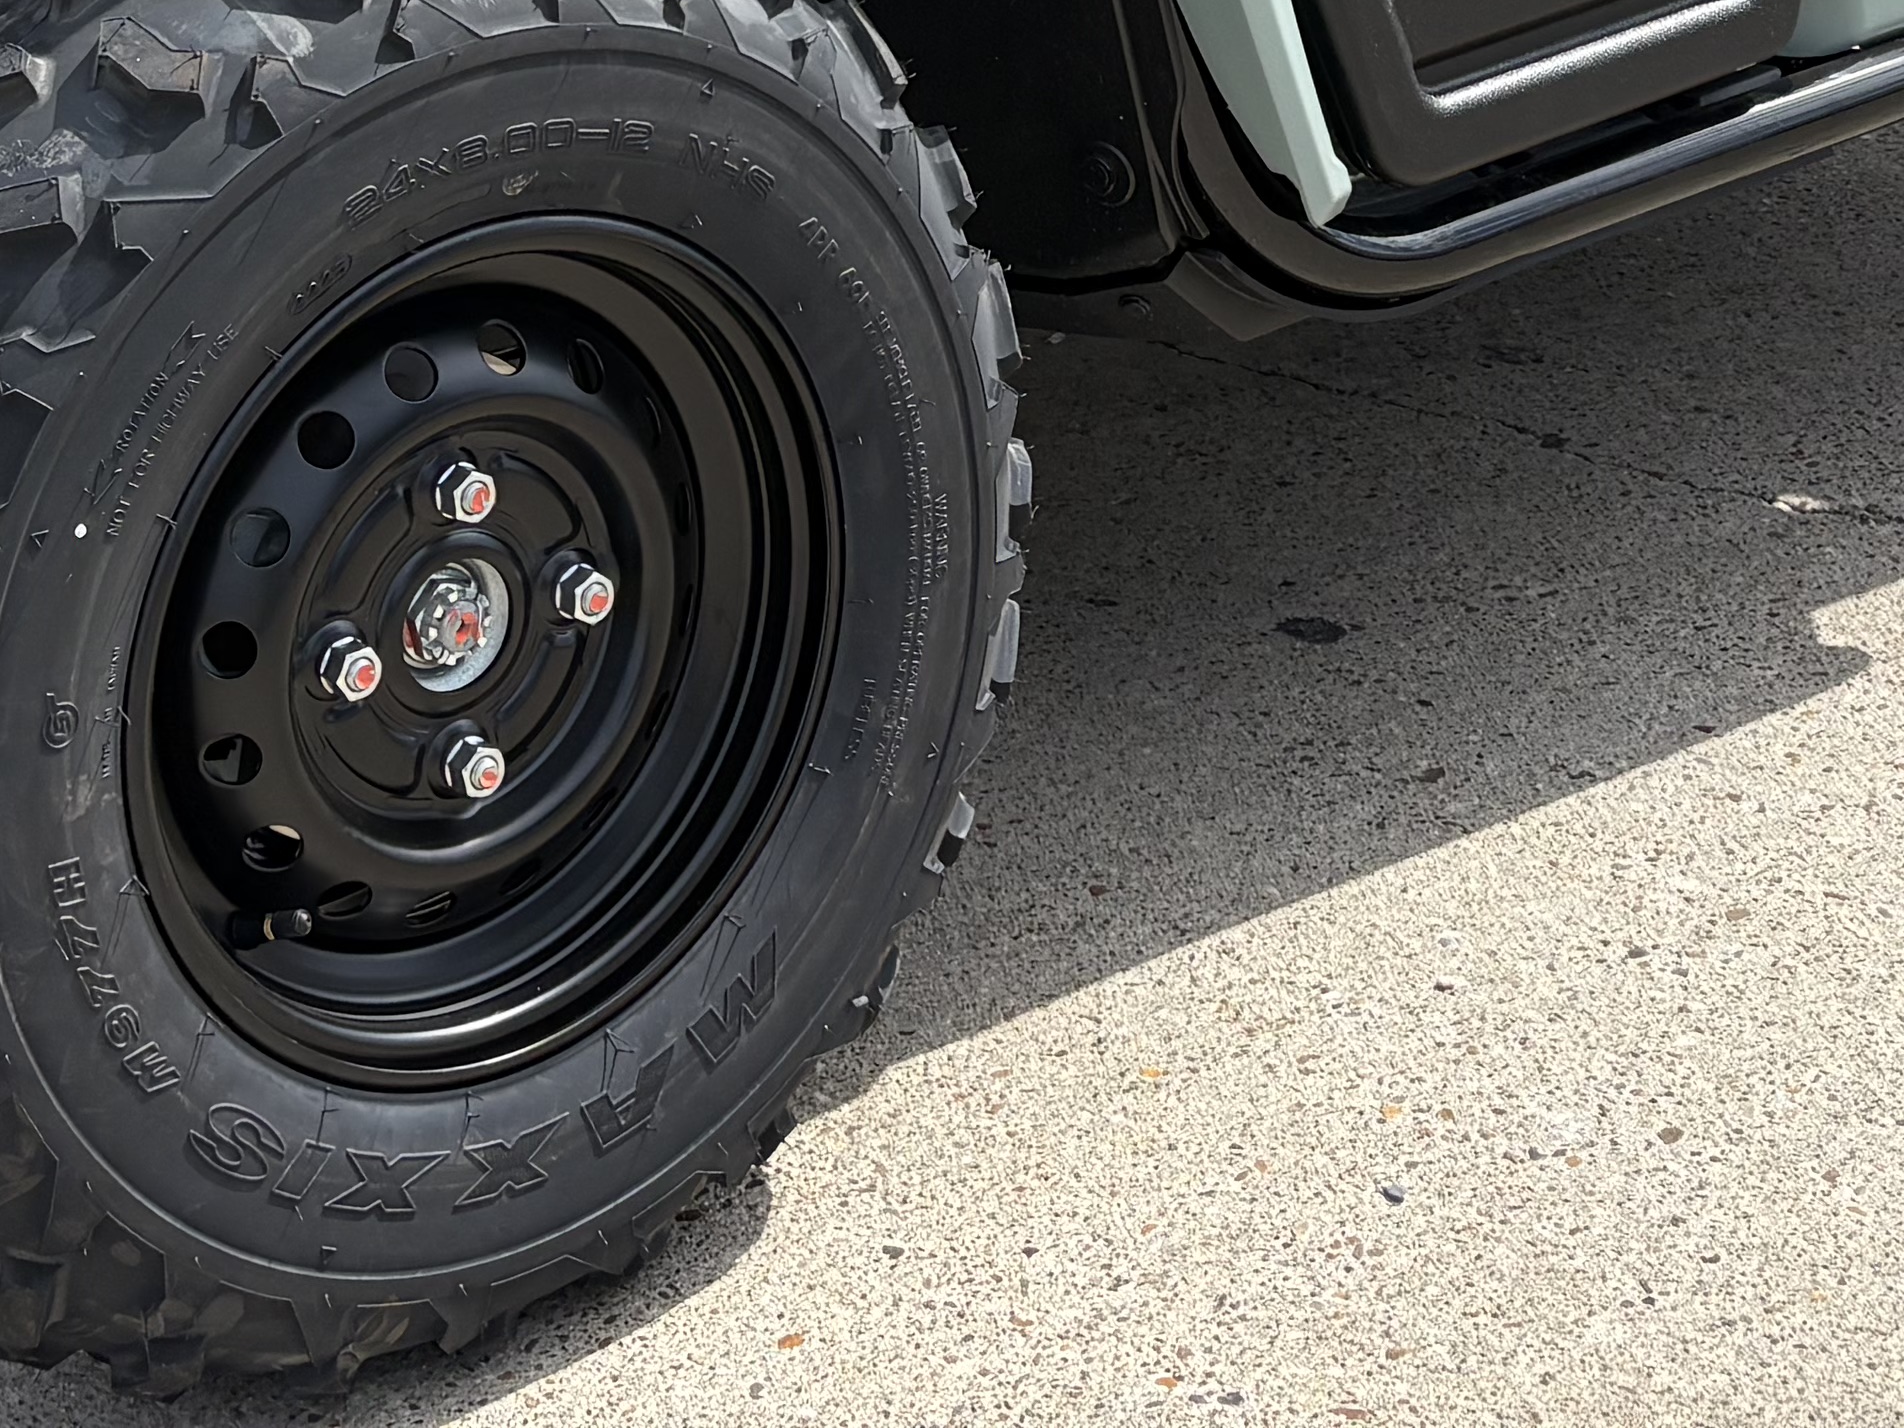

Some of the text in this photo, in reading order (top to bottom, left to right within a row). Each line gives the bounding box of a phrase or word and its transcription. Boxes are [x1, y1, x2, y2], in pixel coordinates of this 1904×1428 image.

[342, 117, 777, 230] 24X8.00-12 NHS
[106, 322, 240, 537] NOT FOR HIGHWAY USE
[115, 371, 170, 453] ROTATION
[44, 855, 184, 1097] M977H
[188, 925, 778, 1216] MAXXIS
